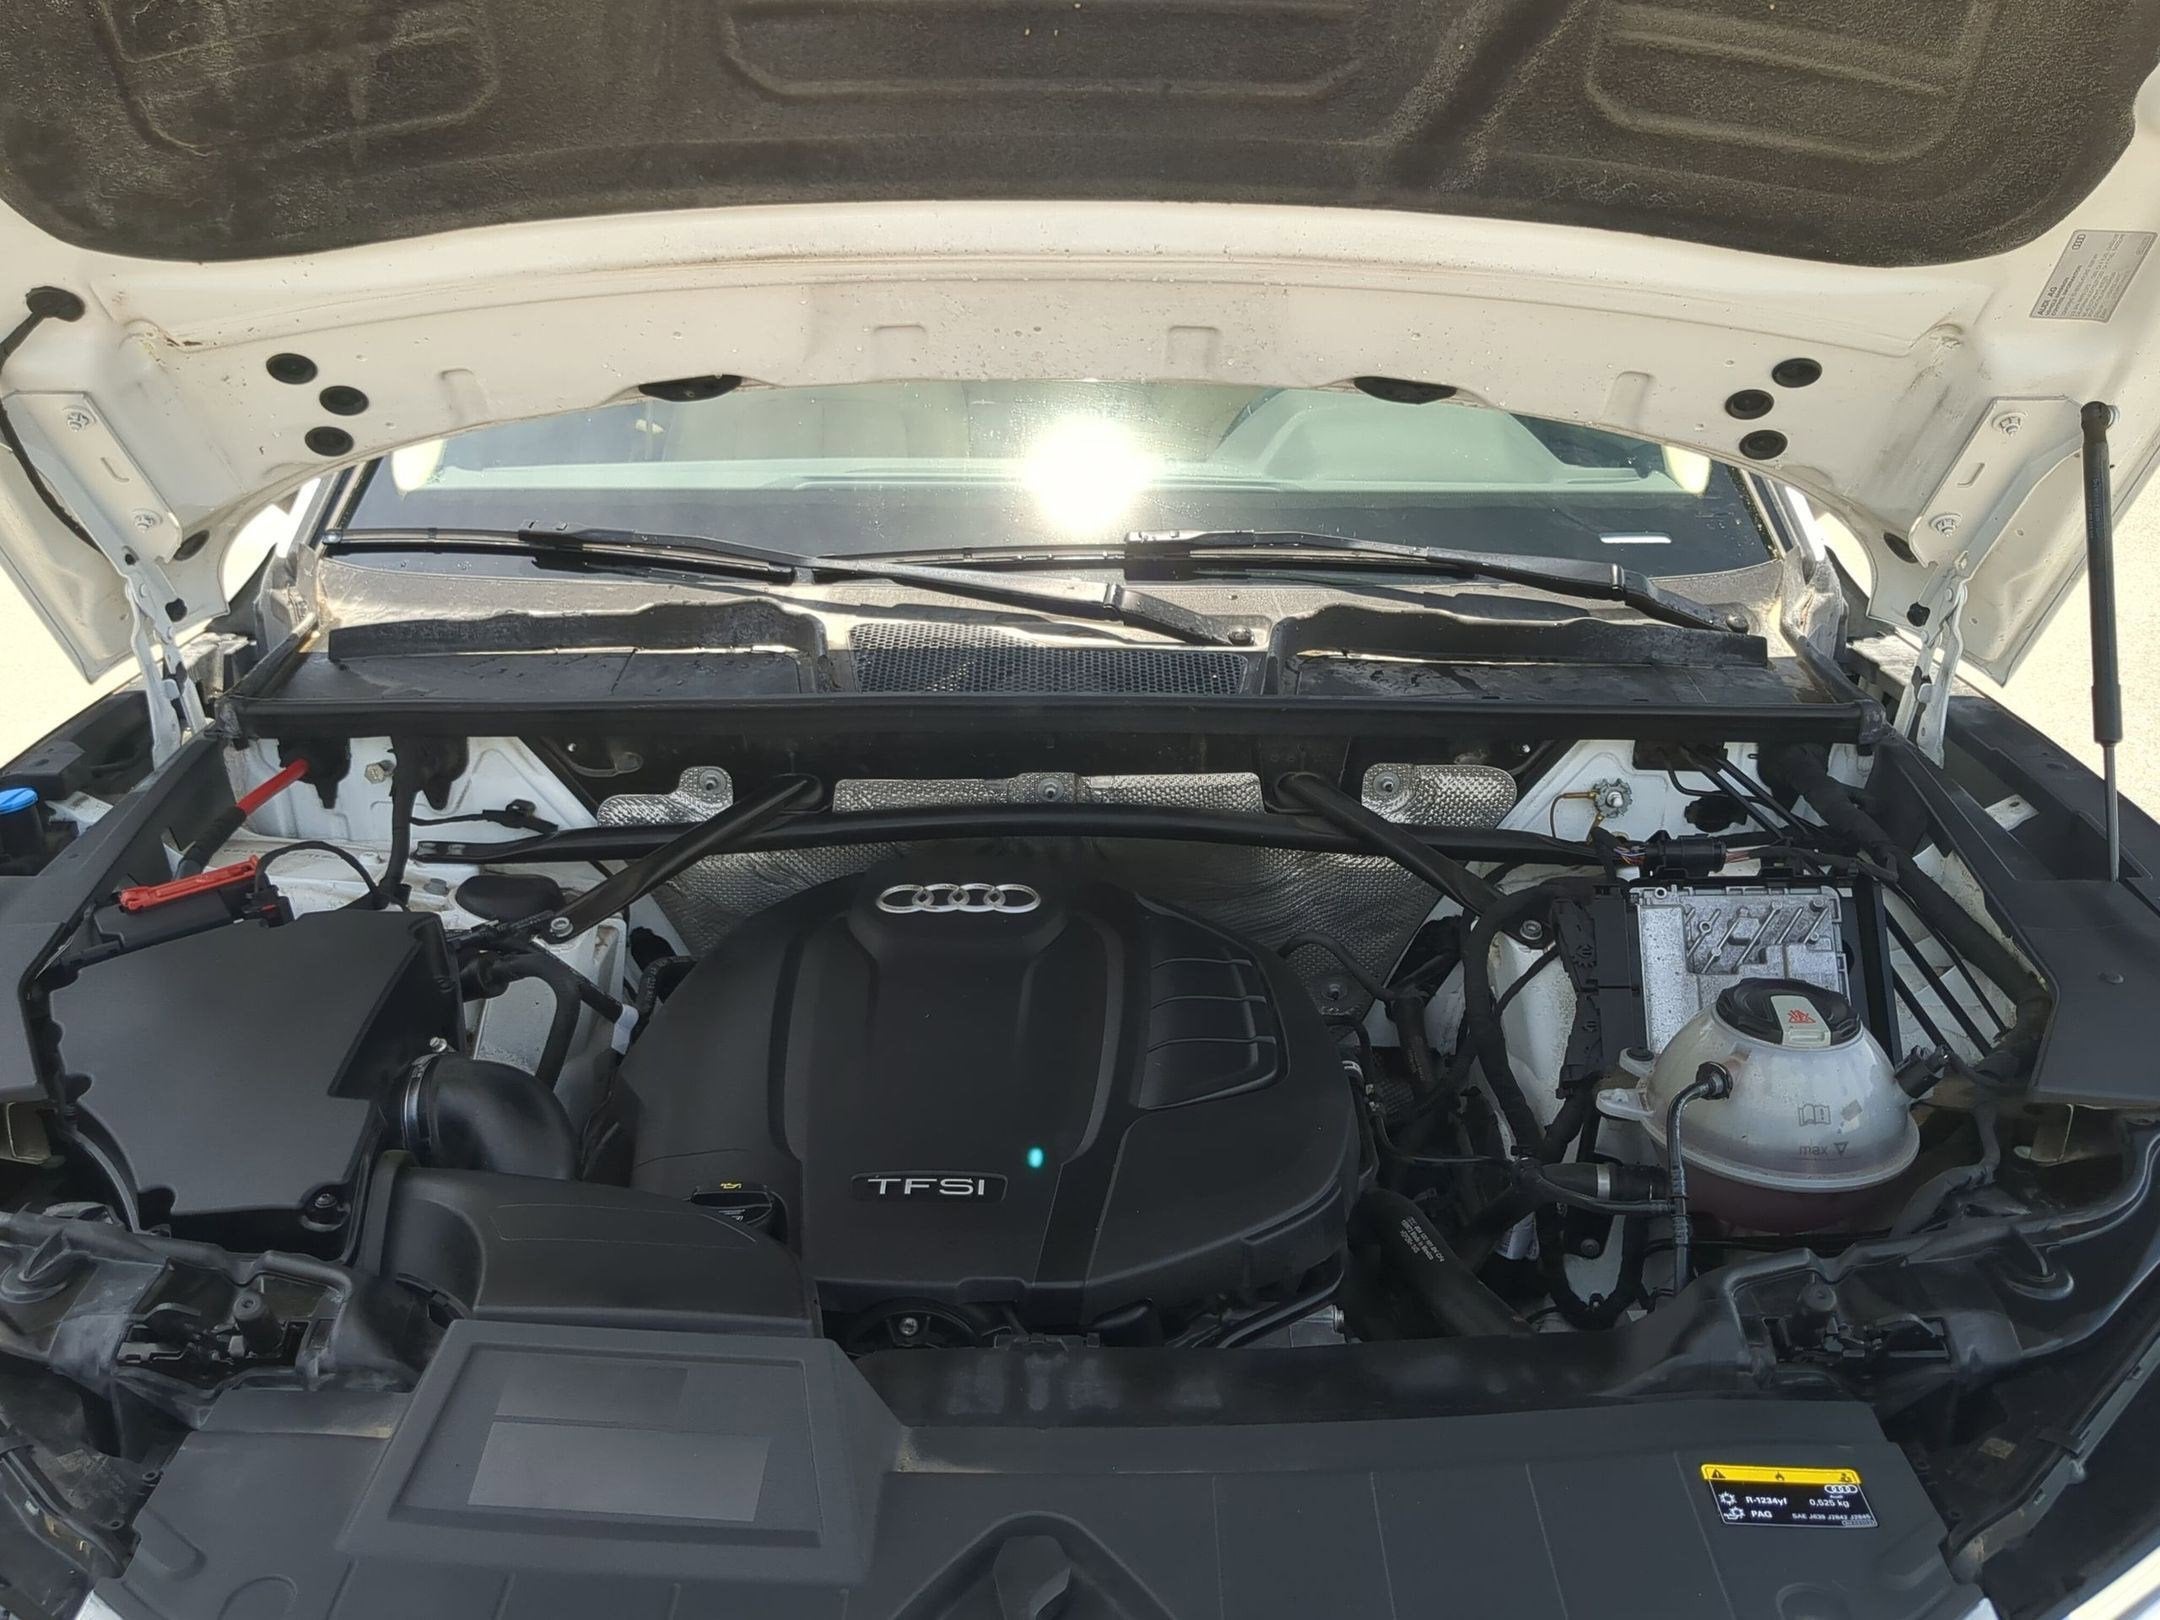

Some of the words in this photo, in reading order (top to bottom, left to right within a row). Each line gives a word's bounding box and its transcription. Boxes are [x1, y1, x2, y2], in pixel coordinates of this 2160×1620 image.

[2038, 299, 2050, 315] AUDI
[2048, 286, 2057, 296] AG
[1799, 1145, 1828, 1155] max
[868, 1178, 985, 1196] TFSI
[1745, 1496, 1788, 1506] R-1234yf
[1837, 1499, 1850, 1508] kg
[1751, 1510, 1773, 1519] PAG
